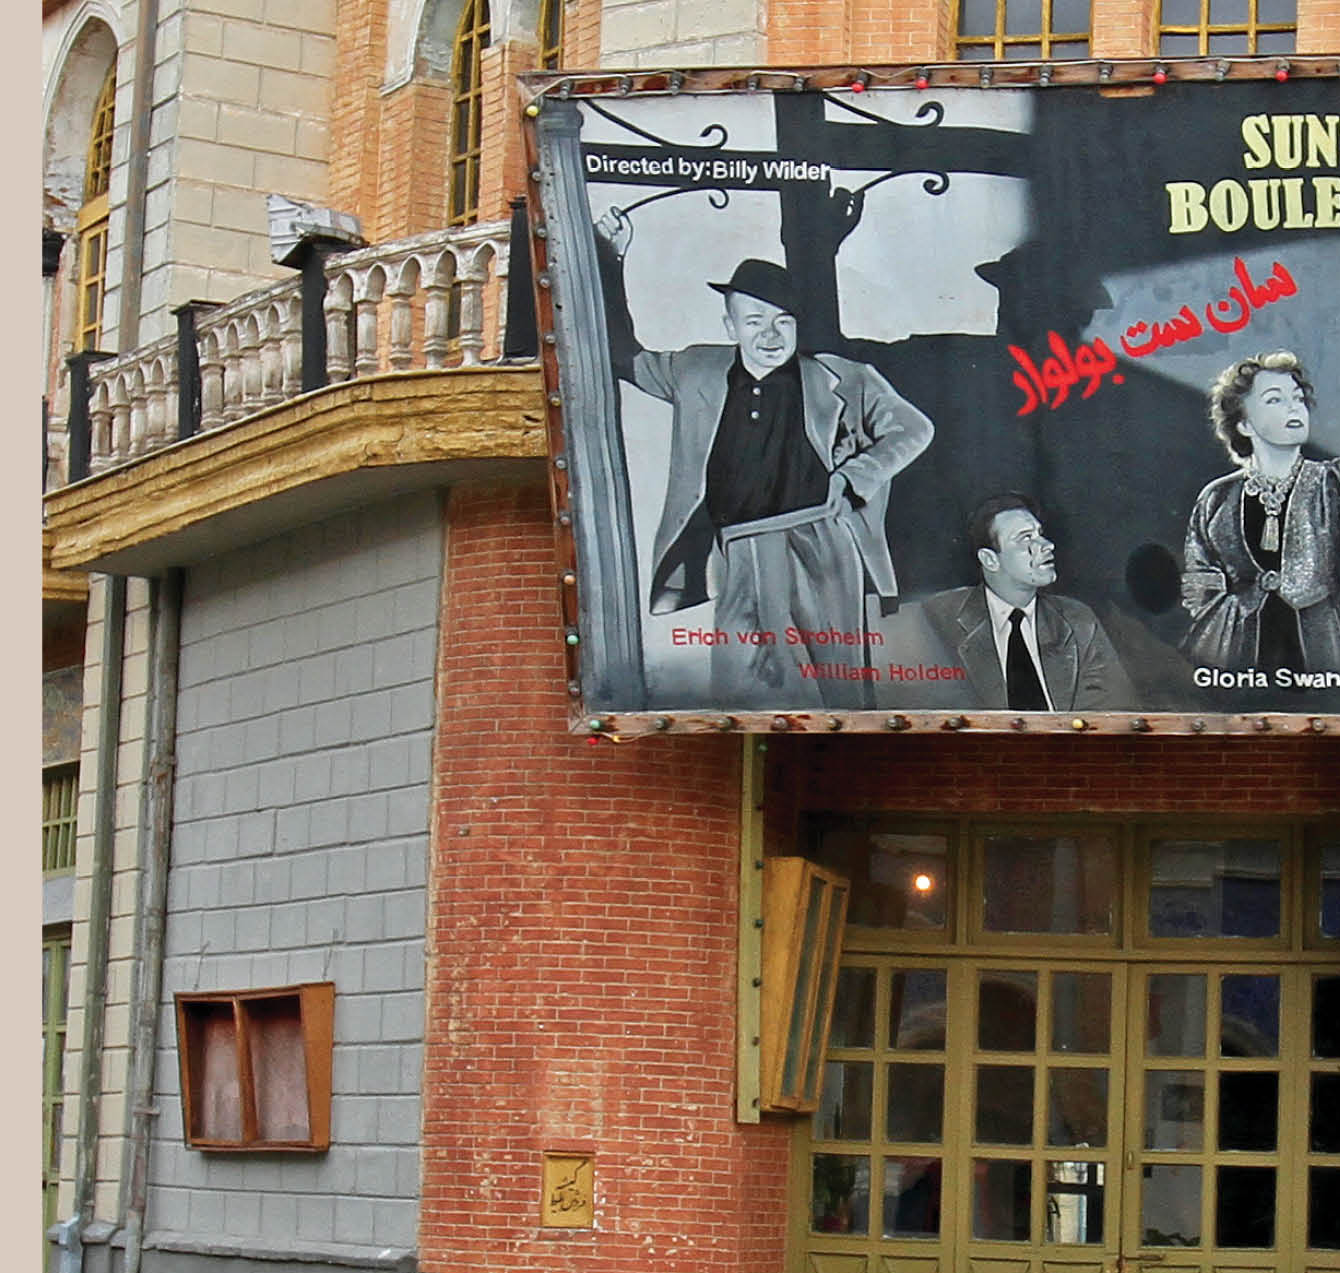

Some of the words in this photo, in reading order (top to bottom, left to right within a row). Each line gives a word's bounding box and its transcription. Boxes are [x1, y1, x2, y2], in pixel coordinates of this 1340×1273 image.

[585, 154, 674, 175] Directed
[763, 161, 831, 181] Wilder
[1206, 256, 1299, 334] سان
[1120, 305, 1204, 359] ست
[1007, 330, 1125, 417] بولوار
[671, 627, 729, 646] Erich
[737, 630, 777, 646] von
[785, 628, 885, 646] Stroheim
[799, 663, 881, 681] William
[889, 663, 966, 681] Holden
[1193, 668, 1269, 688] Gloria
